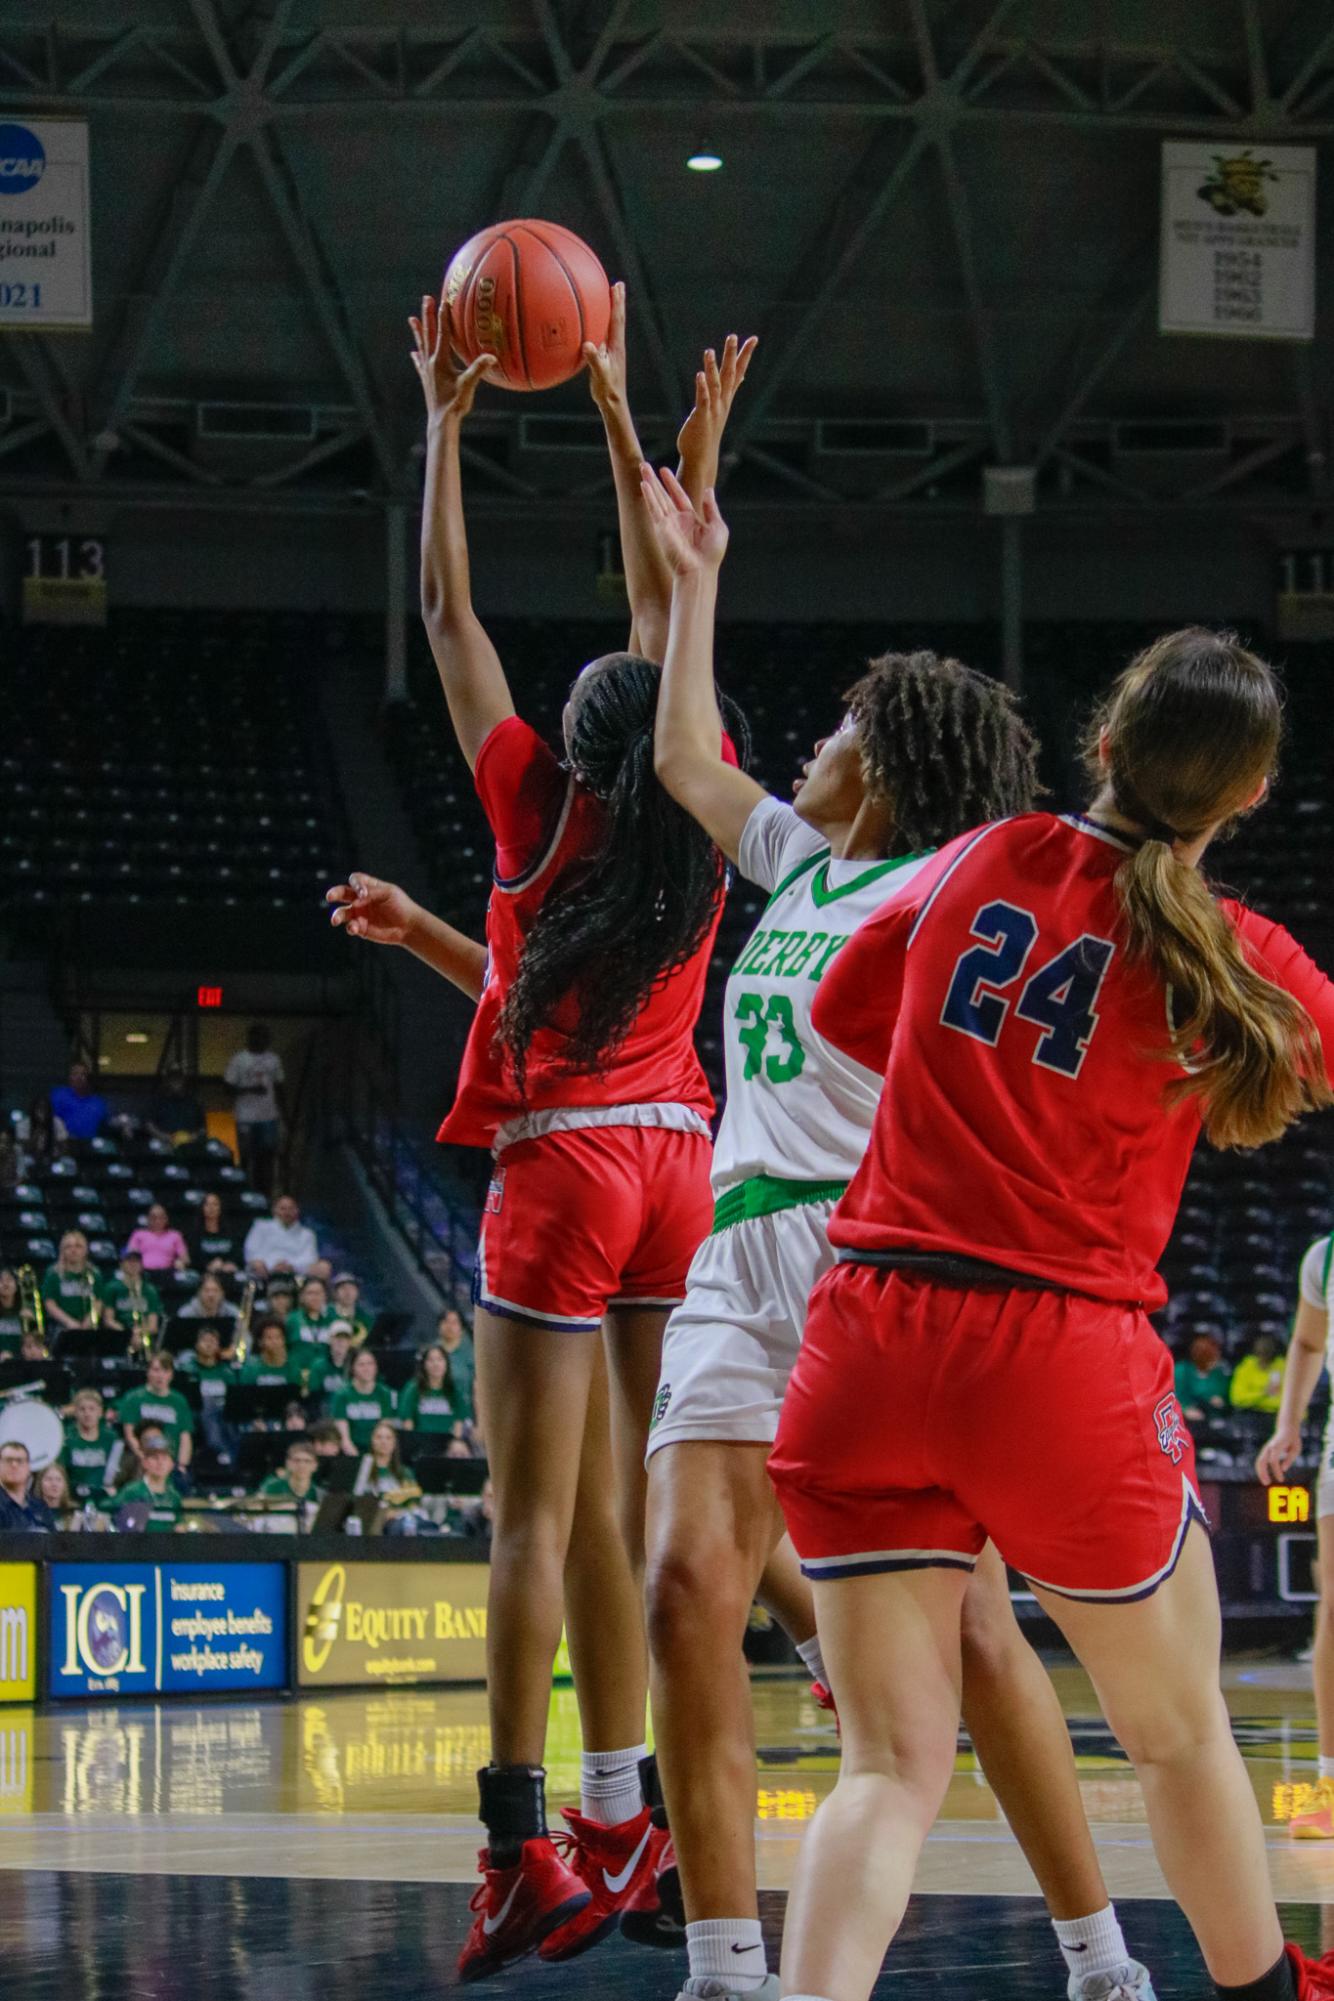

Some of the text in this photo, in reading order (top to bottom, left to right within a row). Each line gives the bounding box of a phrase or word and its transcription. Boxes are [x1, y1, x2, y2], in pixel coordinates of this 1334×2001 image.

[0, 157, 44, 177] CAA
[0, 216, 75, 238] napolis
[27, 539, 105, 580] 113
[731, 929, 851, 982] DERBY
[939, 898, 1116, 1080] 24
[170, 1578, 225, 1601] insurance
[60, 1582, 147, 1676] ICI
[171, 1607, 272, 1642] employee benefits
[345, 1600, 487, 1649] EQUITY BAN
[170, 1642, 264, 1677] workplace safety
